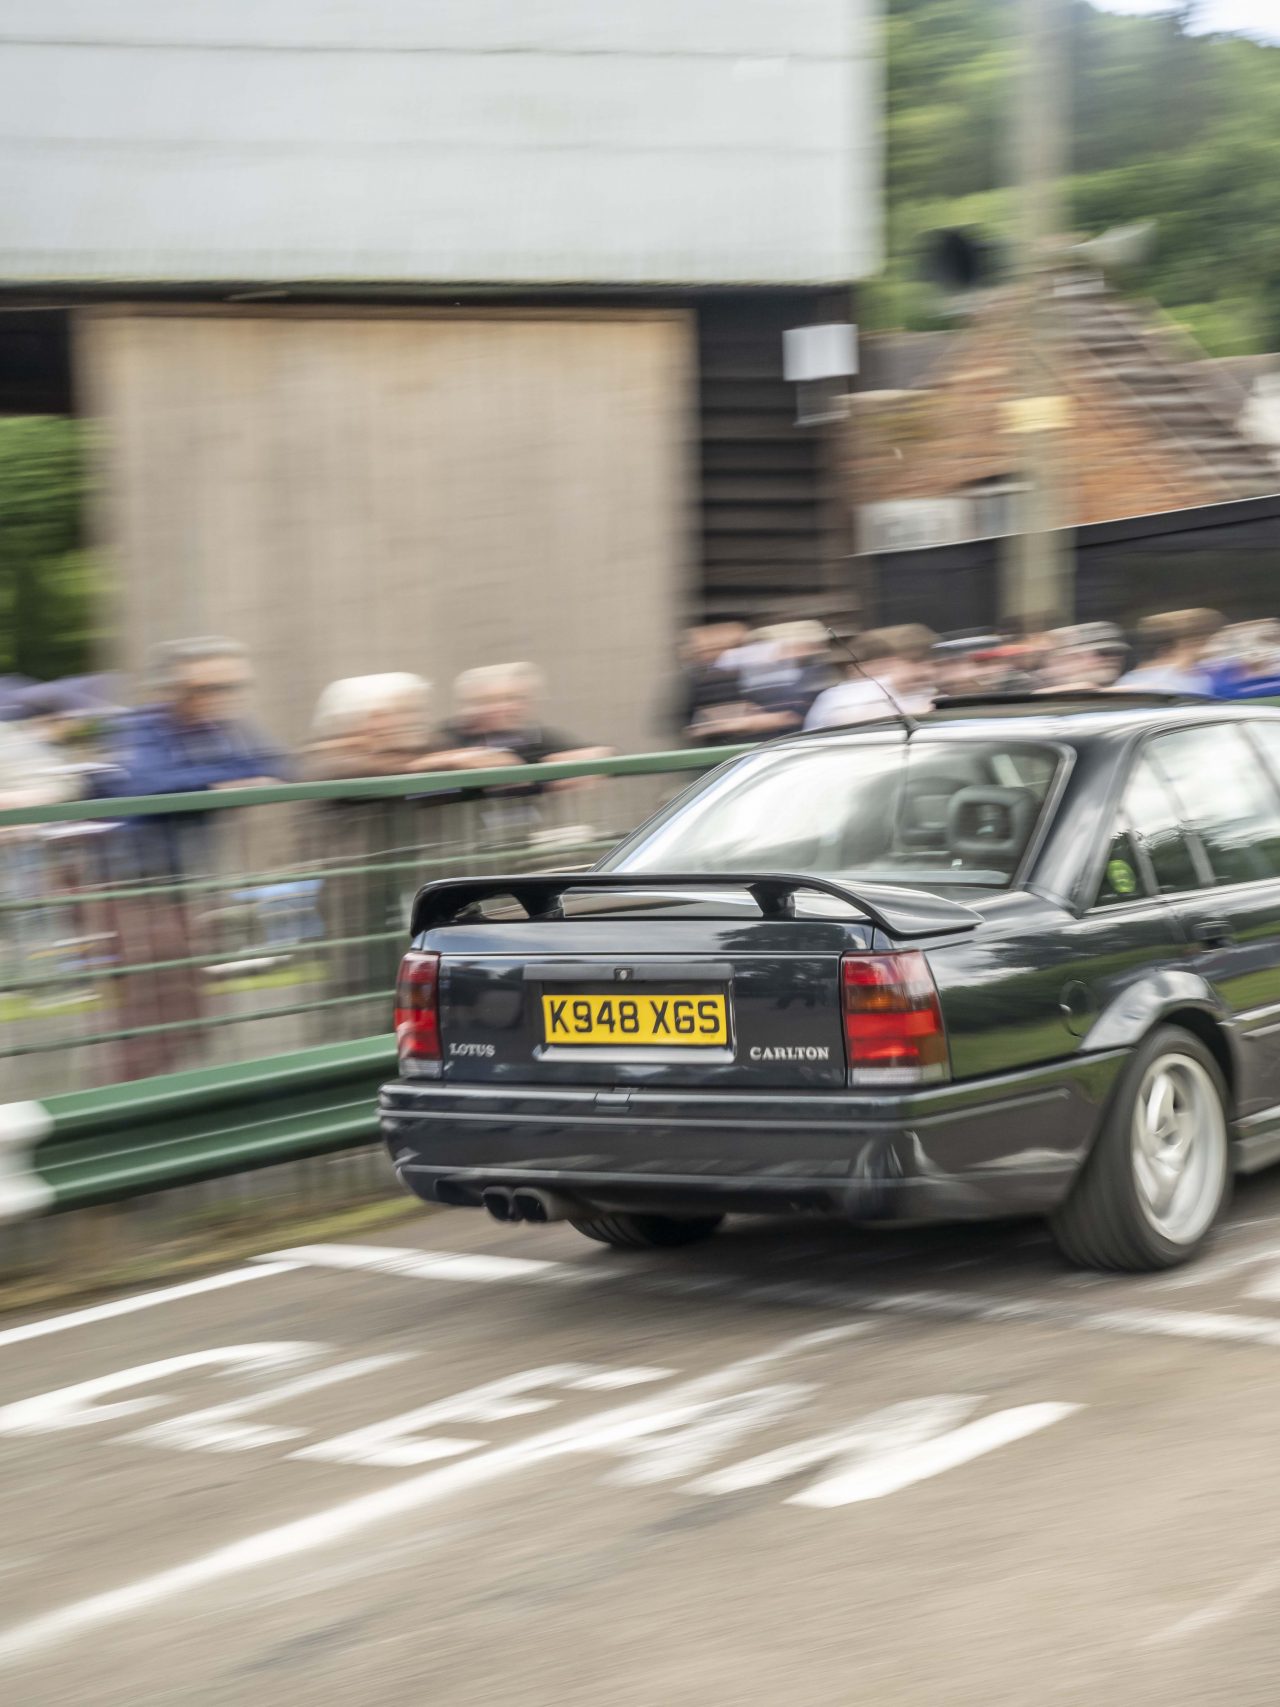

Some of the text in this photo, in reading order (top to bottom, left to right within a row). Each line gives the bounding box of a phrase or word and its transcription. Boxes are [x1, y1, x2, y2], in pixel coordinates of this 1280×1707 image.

[549, 999, 721, 1034] K948 XGS
[449, 1042, 496, 1058] LOTUS
[749, 1046, 830, 1061] CARLTON
